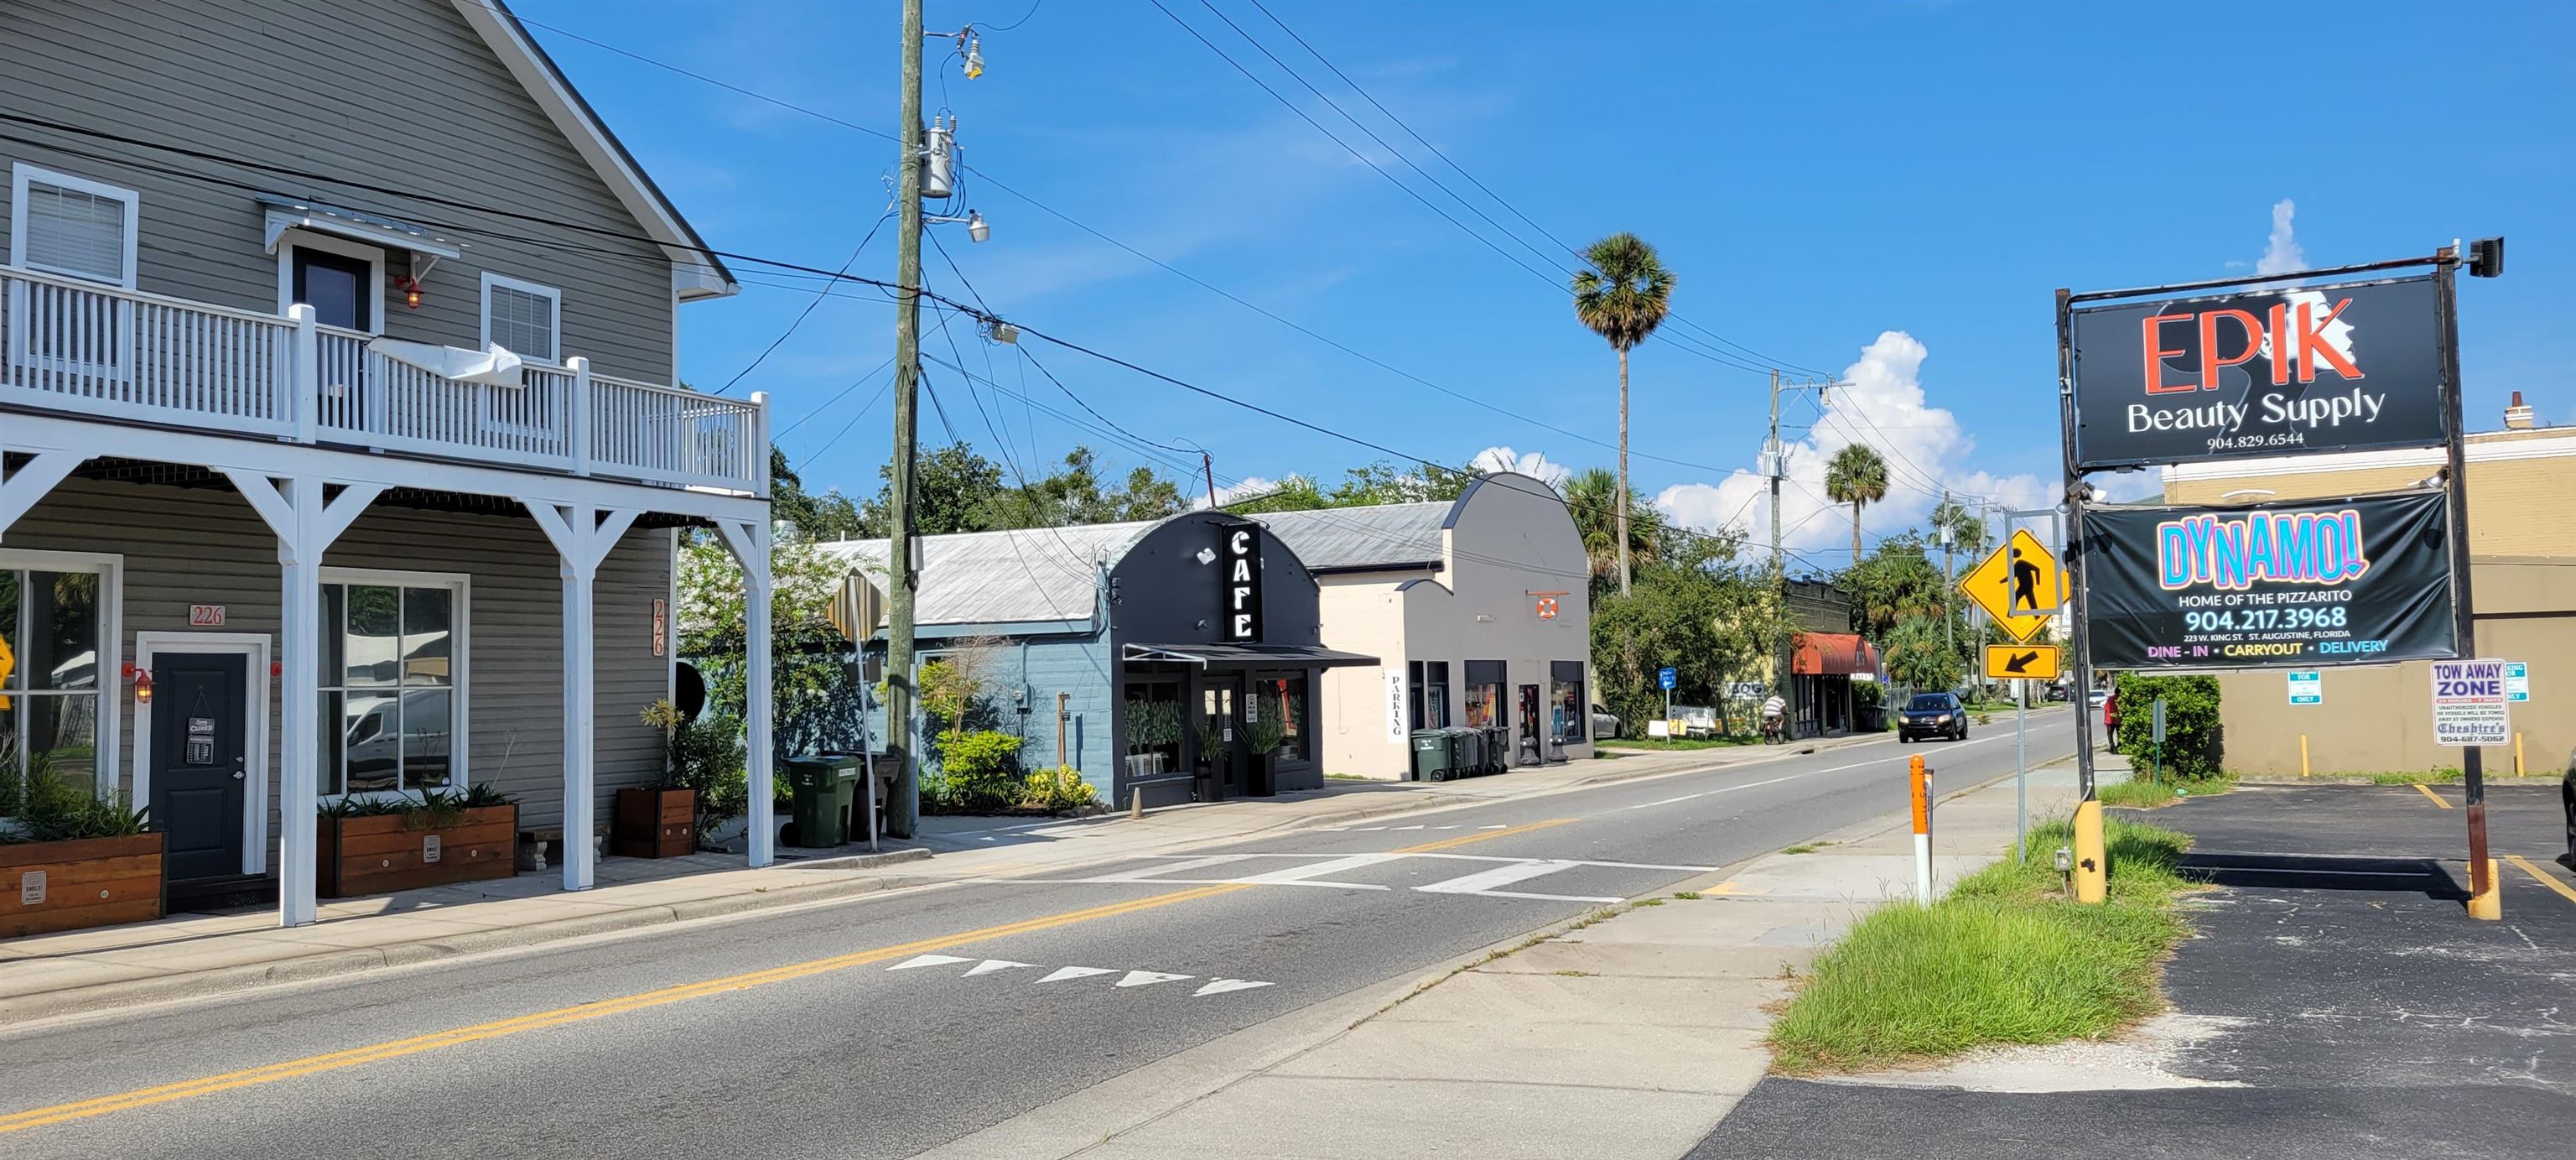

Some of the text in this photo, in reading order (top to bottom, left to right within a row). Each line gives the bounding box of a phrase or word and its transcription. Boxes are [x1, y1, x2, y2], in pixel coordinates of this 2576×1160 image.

[2142, 298, 2365, 395] EPIK
[2128, 388, 2386, 432] Beauty Supply
[2207, 433, 2304, 450] 904.829.6544
[2158, 510, 2369, 590] DYNAMO!
[1232, 531, 1251, 637] CAFE
[2179, 590, 2352, 606] HOME OF THE PIZZARITO
[194, 606, 221, 625] 226
[2185, 606, 2346, 631] 904.217.3968
[2314, 630, 2350, 638] FLORIDA
[2148, 646, 2182, 658] DINE
[2193, 645, 2209, 657] IN
[2225, 643, 2303, 656] CARRYOUT
[2319, 640, 2388, 653] DELIVERY
[2434, 663, 2501, 679] TOW AWAY
[2438, 680, 2501, 696] ZONE
[1392, 676, 1401, 736] PARKING
[2438, 722, 2506, 734] Cheshire's
